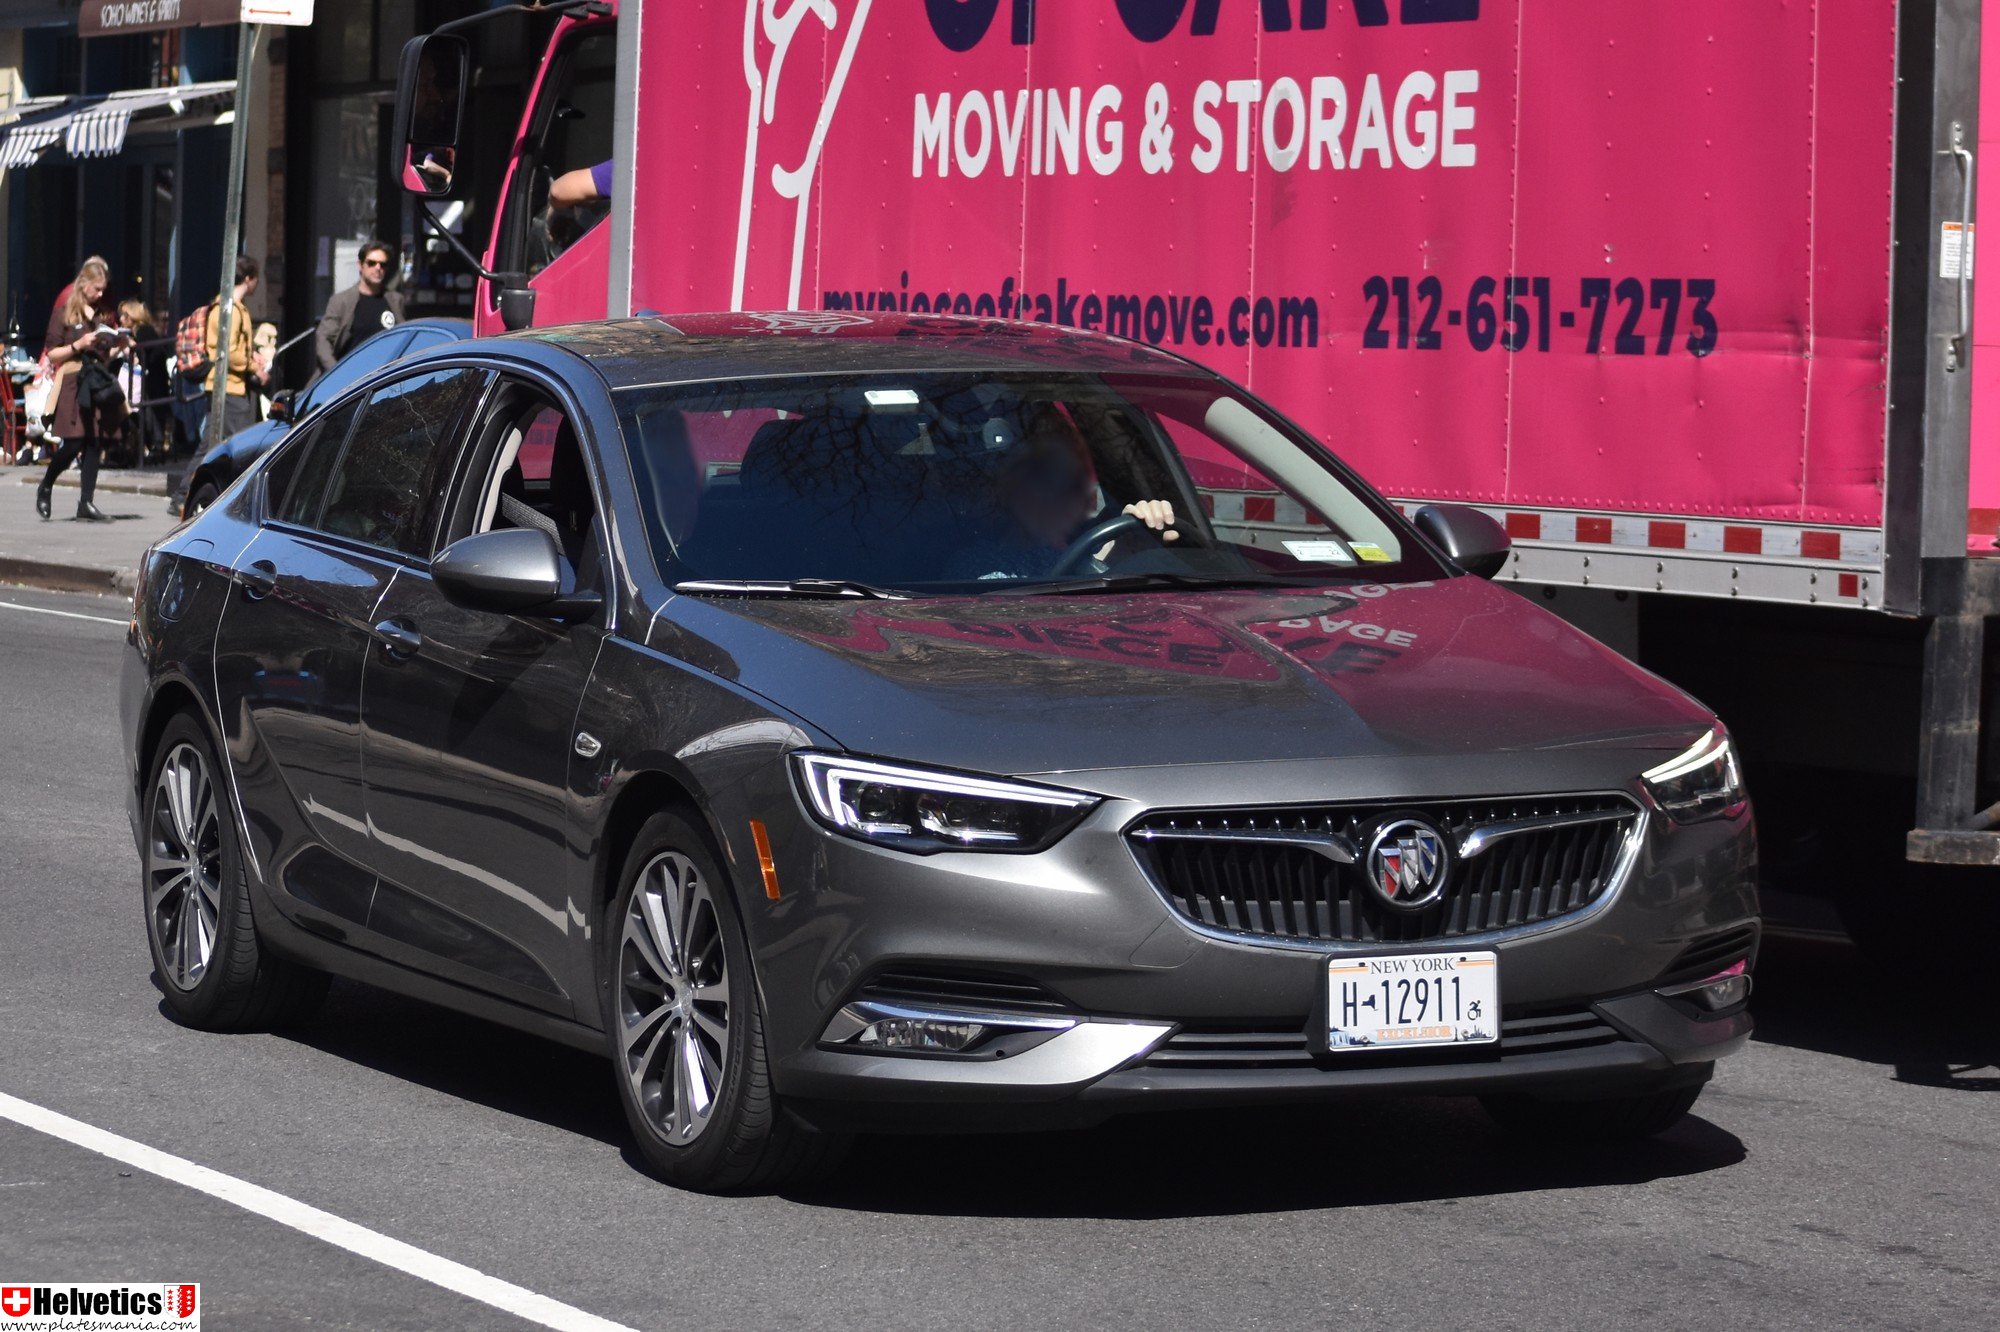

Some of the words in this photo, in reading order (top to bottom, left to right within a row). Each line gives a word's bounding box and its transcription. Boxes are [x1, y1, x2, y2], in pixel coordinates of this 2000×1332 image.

[102, 4, 124, 28] SOHO
[912, 84, 1123, 178] MOVING
[1139, 82, 1174, 174] &
[1191, 69, 1479, 173] STORAGE
[1362, 275, 1719, 358] 212-651-7273
[1370, 959, 1407, 975] NEW
[1412, 957, 1455, 972] YORK
